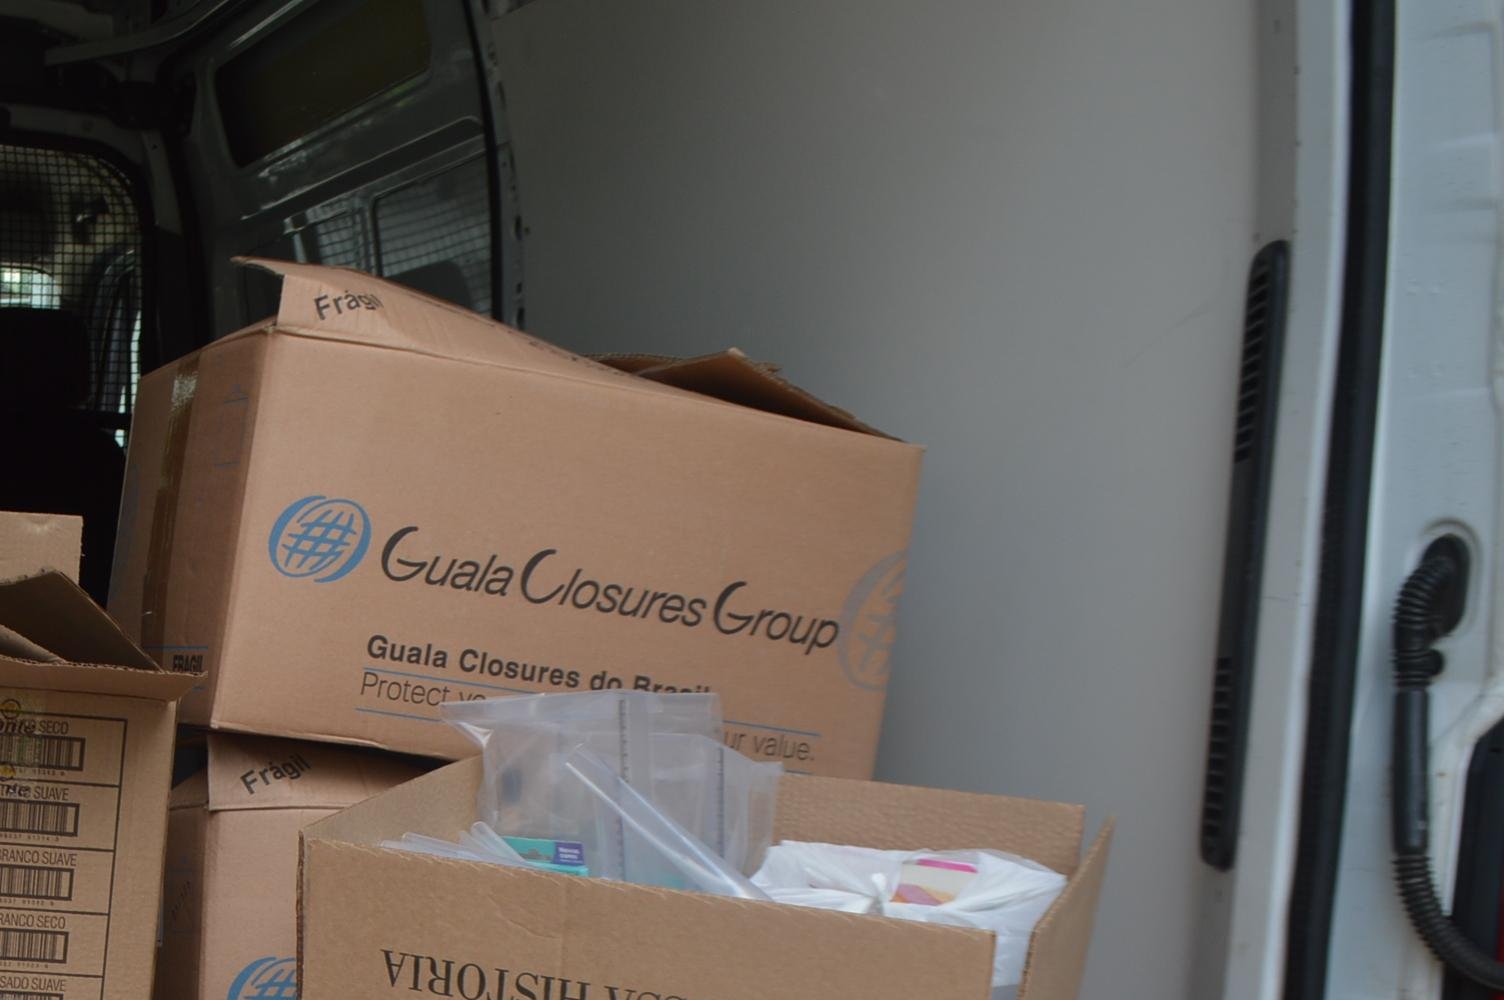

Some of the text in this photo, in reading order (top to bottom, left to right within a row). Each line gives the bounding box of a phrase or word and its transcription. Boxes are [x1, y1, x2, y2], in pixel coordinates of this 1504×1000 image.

[313, 289, 385, 320] Frágil
[380, 525, 841, 656] Guala Closures Group
[367, 634, 448, 670] Guala
[458, 648, 581, 689] Closures
[361, 672, 450, 707] Protect
[38, 720, 70, 735] SECO
[753, 734, 815, 762] value.
[239, 753, 313, 796] Frágil
[33, 785, 70, 801] SUAVE
[41, 851, 78, 867] SUAVE
[36, 914, 66, 930] SECO
[31, 977, 67, 992] SUAVE
